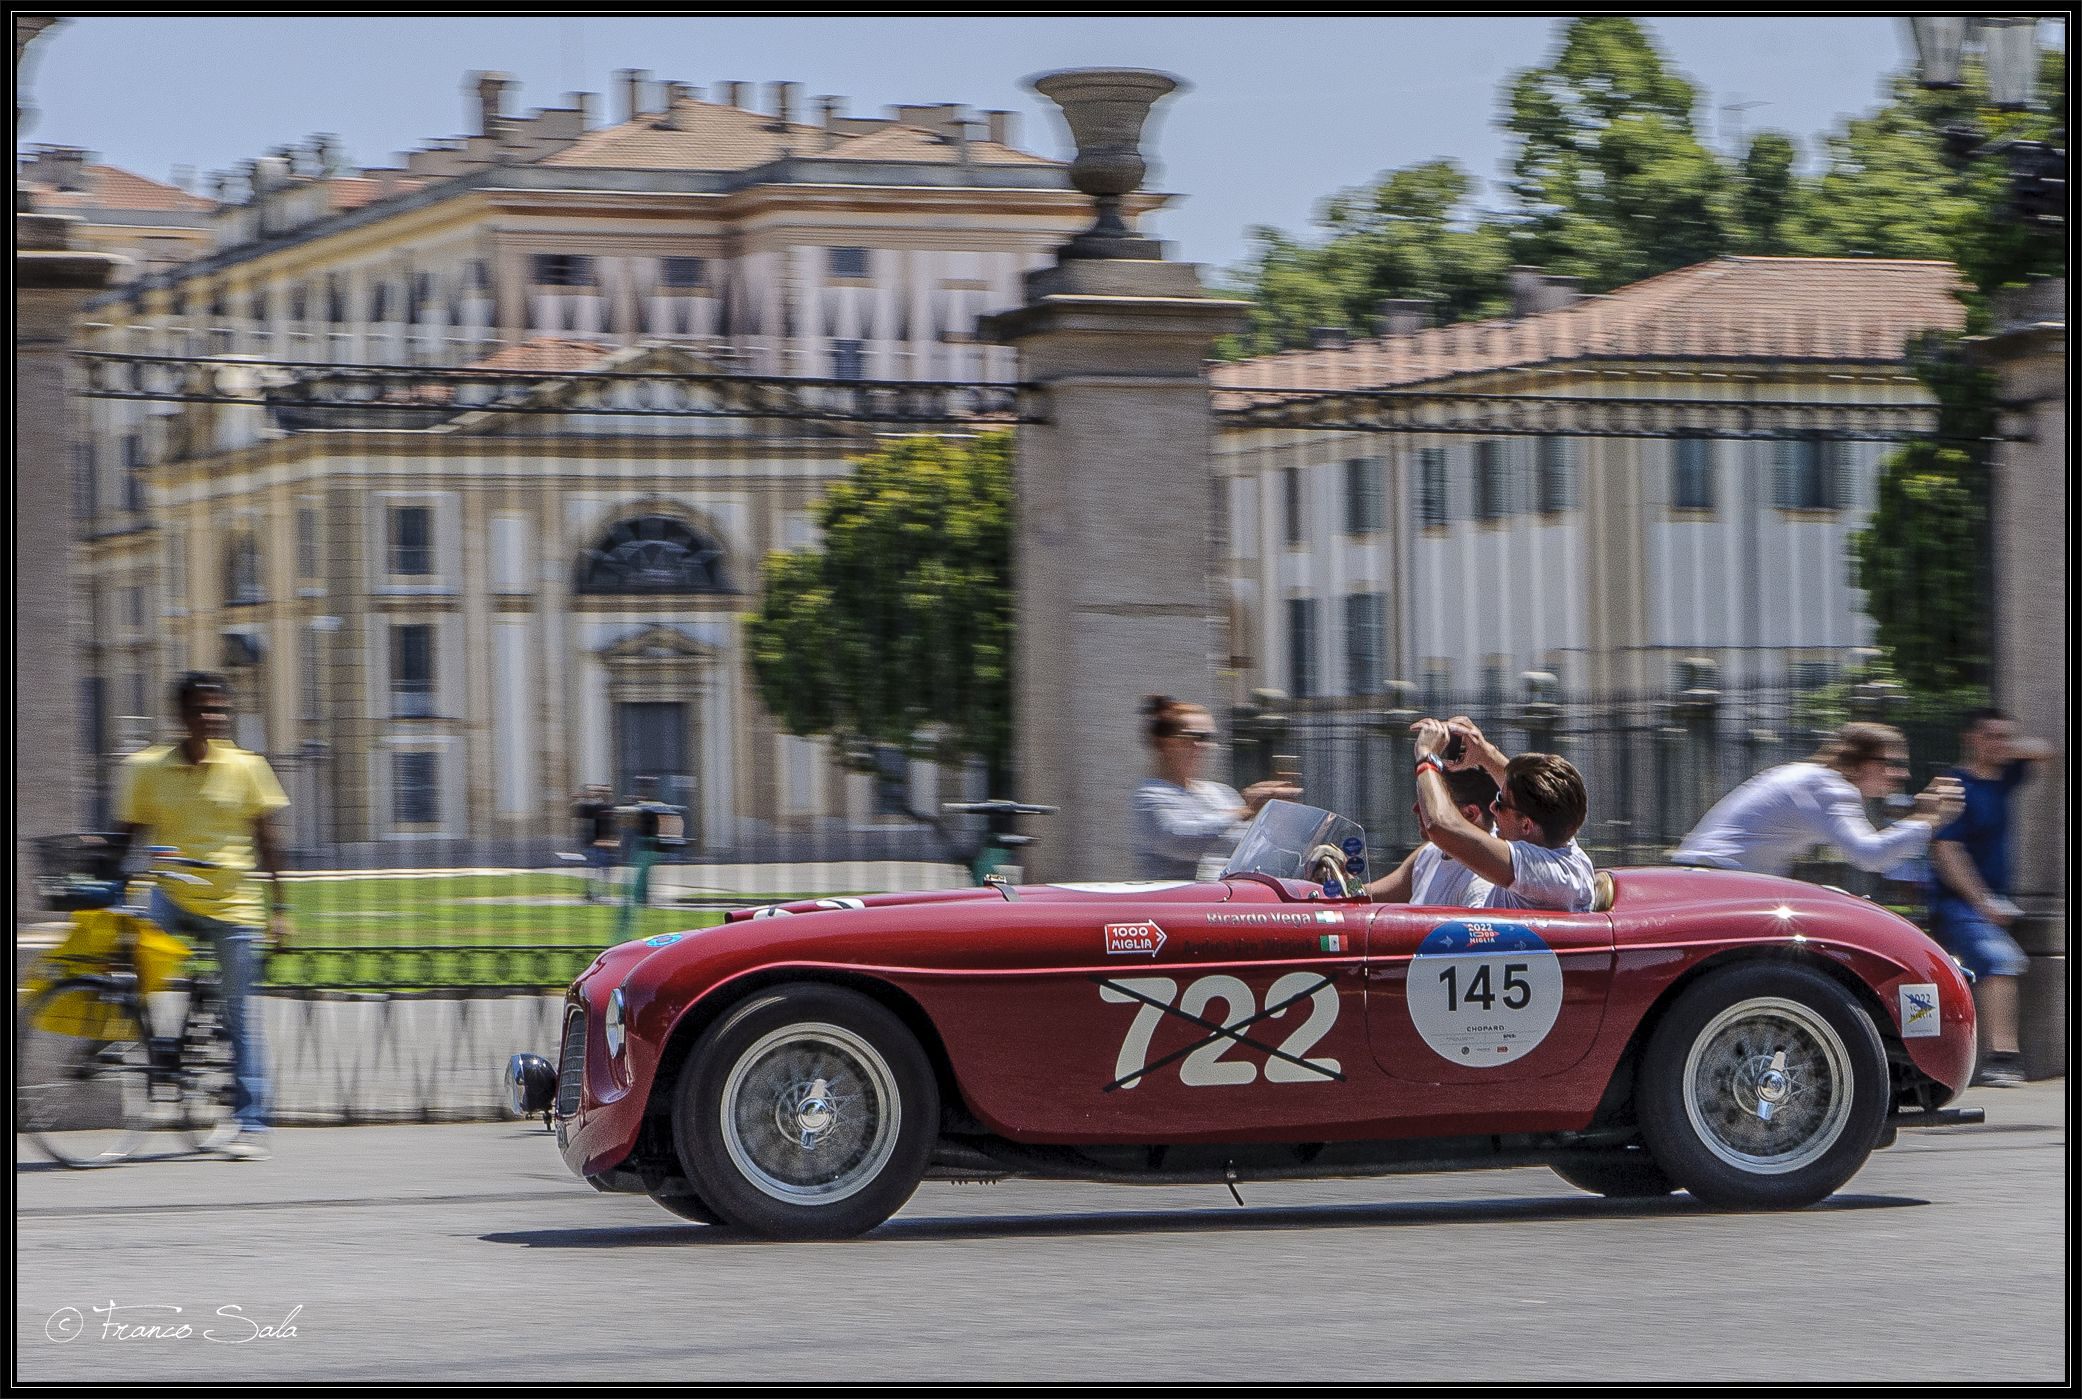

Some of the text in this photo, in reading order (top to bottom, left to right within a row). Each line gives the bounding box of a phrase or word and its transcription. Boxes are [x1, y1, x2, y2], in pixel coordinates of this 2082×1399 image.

[1206, 910, 1312, 929] Ricardo Vega
[1112, 926, 1149, 938] 1000
[1467, 923, 1493, 932] 2022
[1111, 938, 1152, 950] MIGLIA
[1439, 964, 1532, 1012] 145
[1099, 972, 1341, 1089] 722
[1466, 1025, 1505, 1033] CHOPARD
